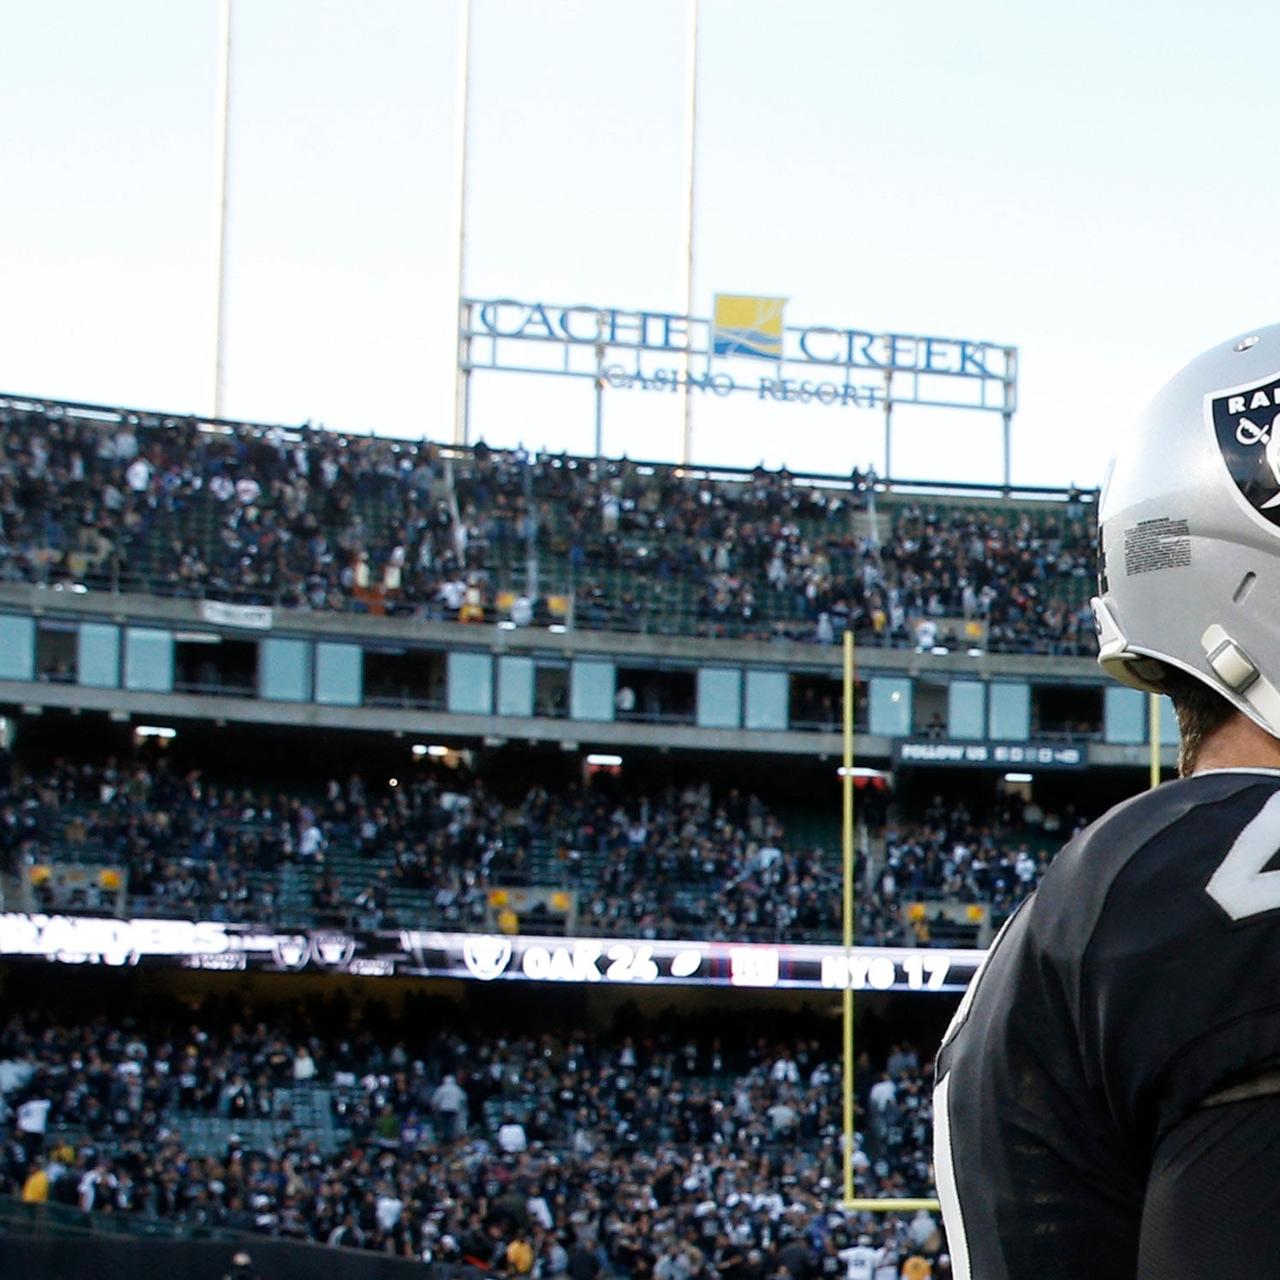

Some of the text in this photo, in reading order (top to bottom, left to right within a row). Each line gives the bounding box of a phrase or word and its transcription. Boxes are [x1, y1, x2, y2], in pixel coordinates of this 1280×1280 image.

[481, 299, 1006, 380] CACHE CREEK
[602, 364, 886, 409] CASINO RESORT
[522, 940, 602, 981] OAK
[901, 956, 951, 990] 17
